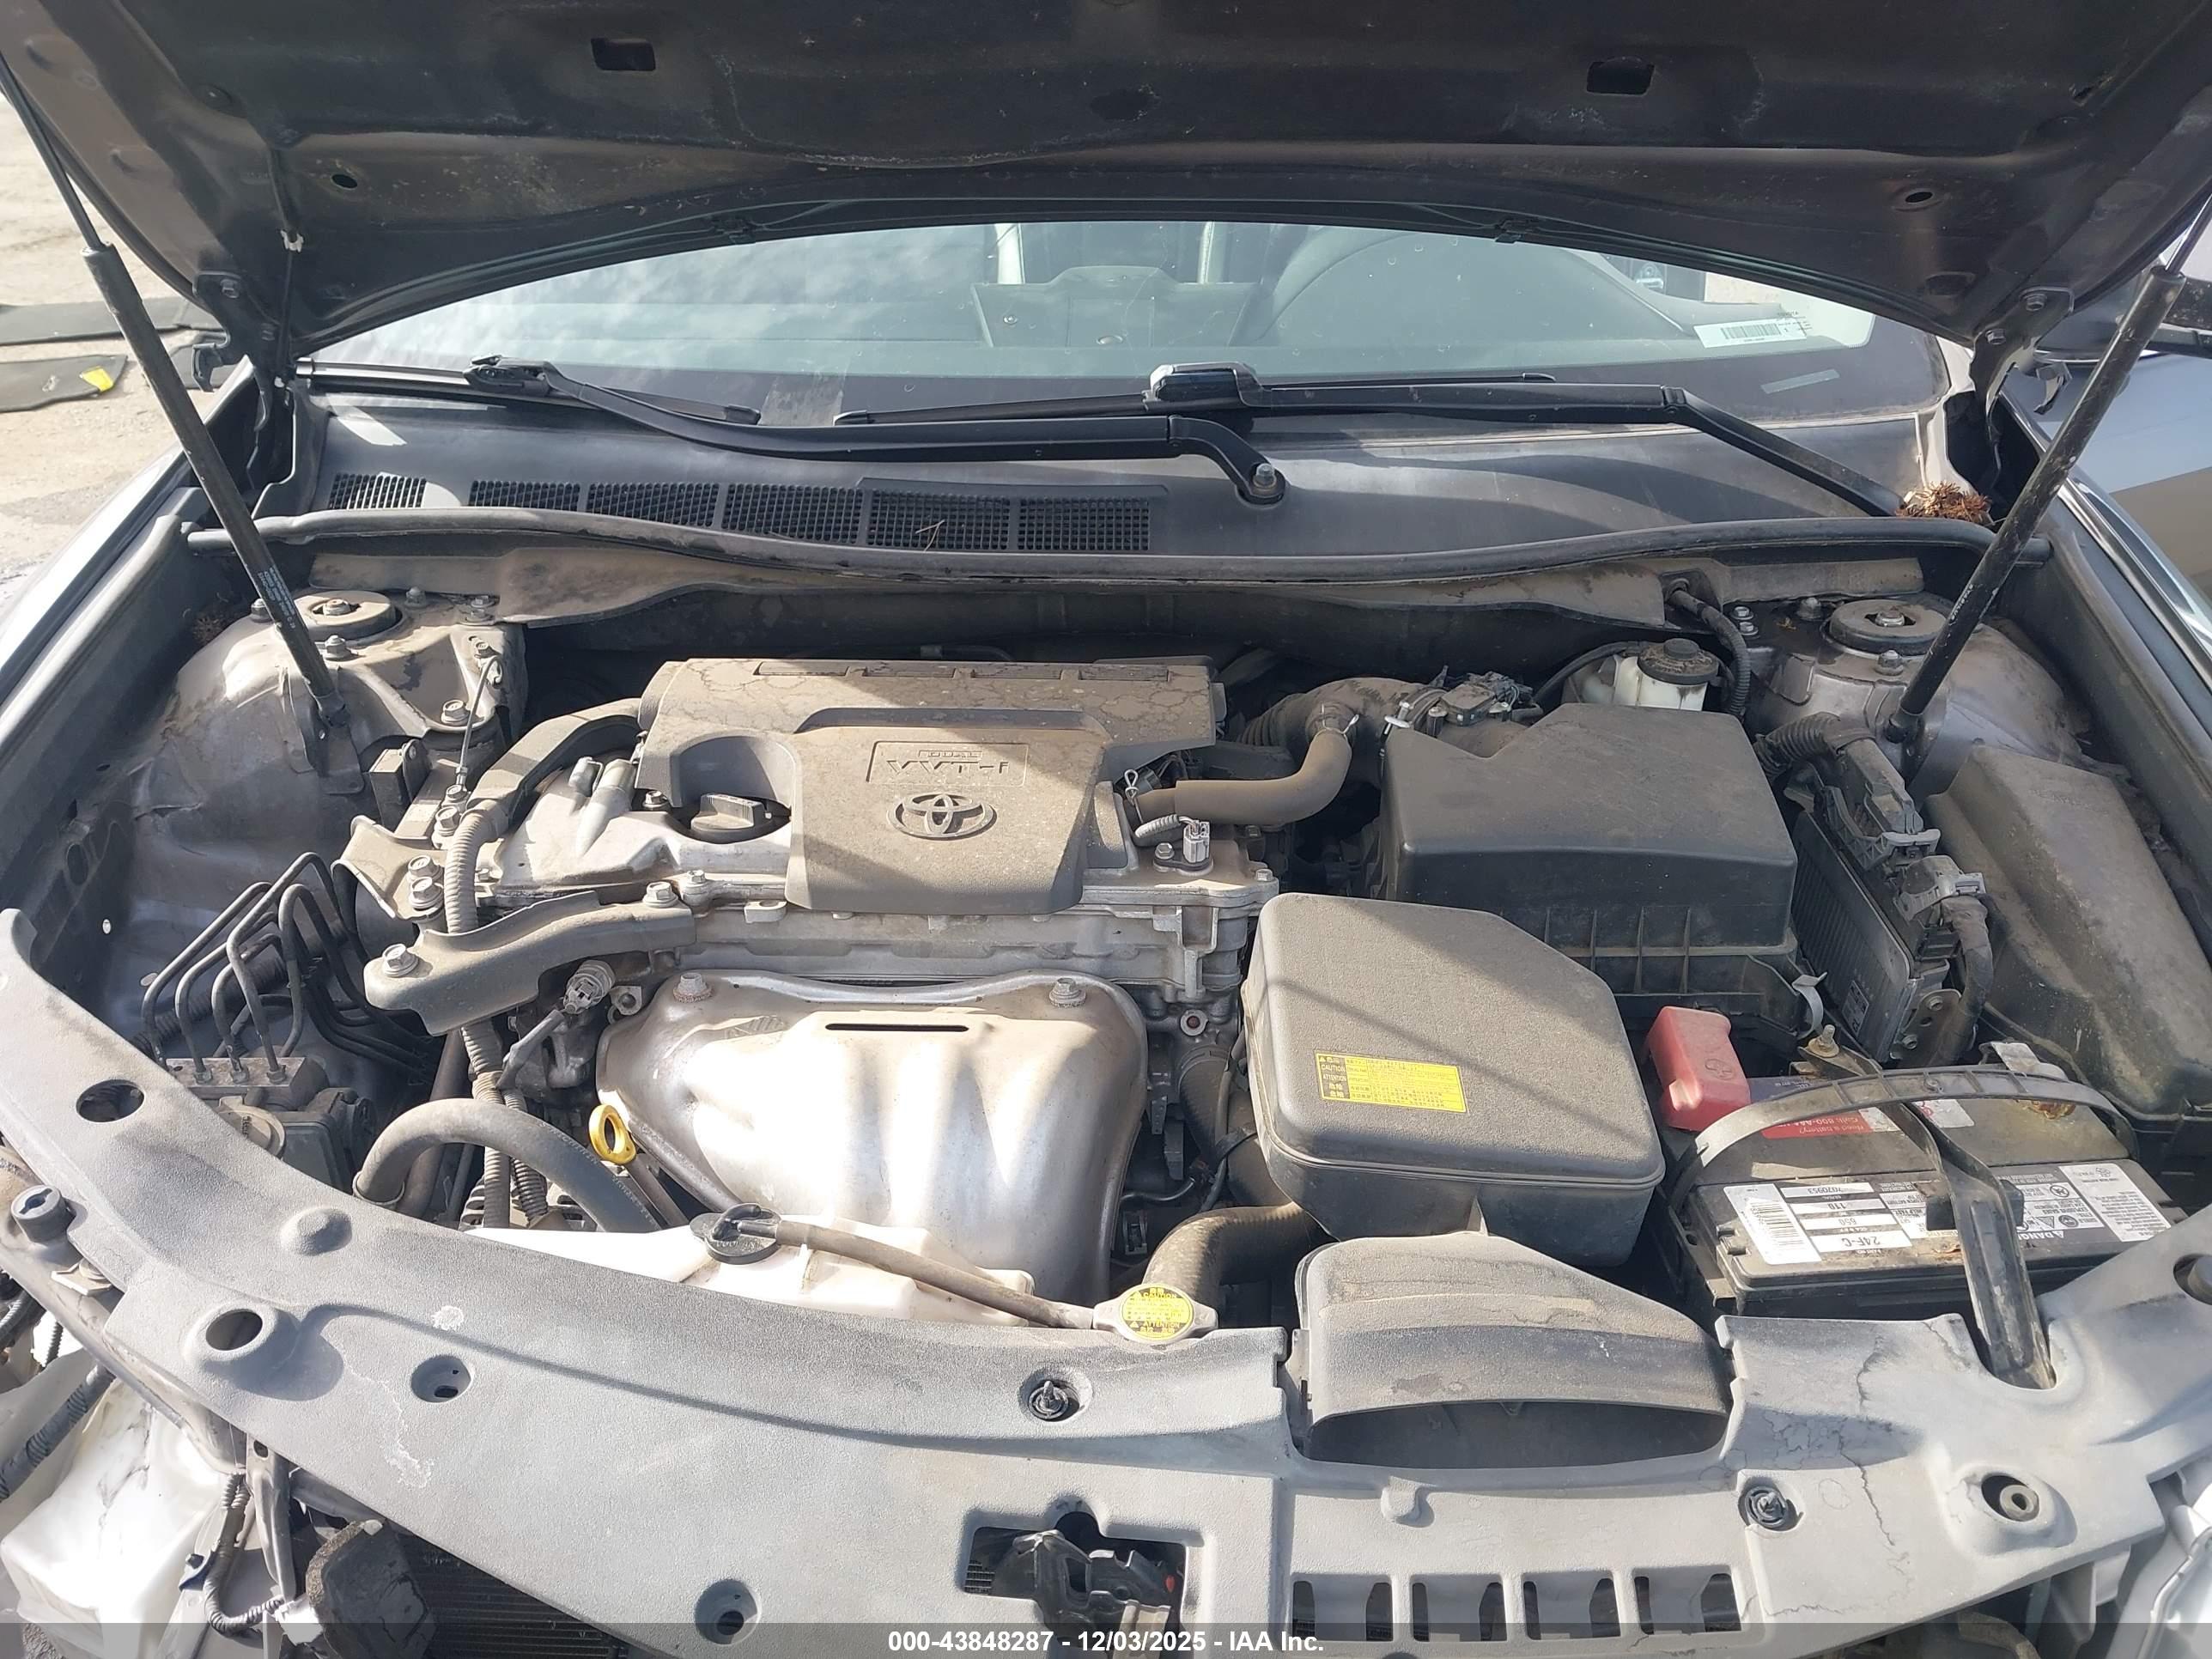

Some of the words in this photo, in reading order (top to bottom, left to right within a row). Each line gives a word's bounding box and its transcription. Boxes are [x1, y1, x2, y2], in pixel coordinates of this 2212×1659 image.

[1321, 1064, 1346, 1073] CAUTION
[2018, 1231, 2055, 1240] DANG
[1842, 1237, 1881, 1247] 24F-C
